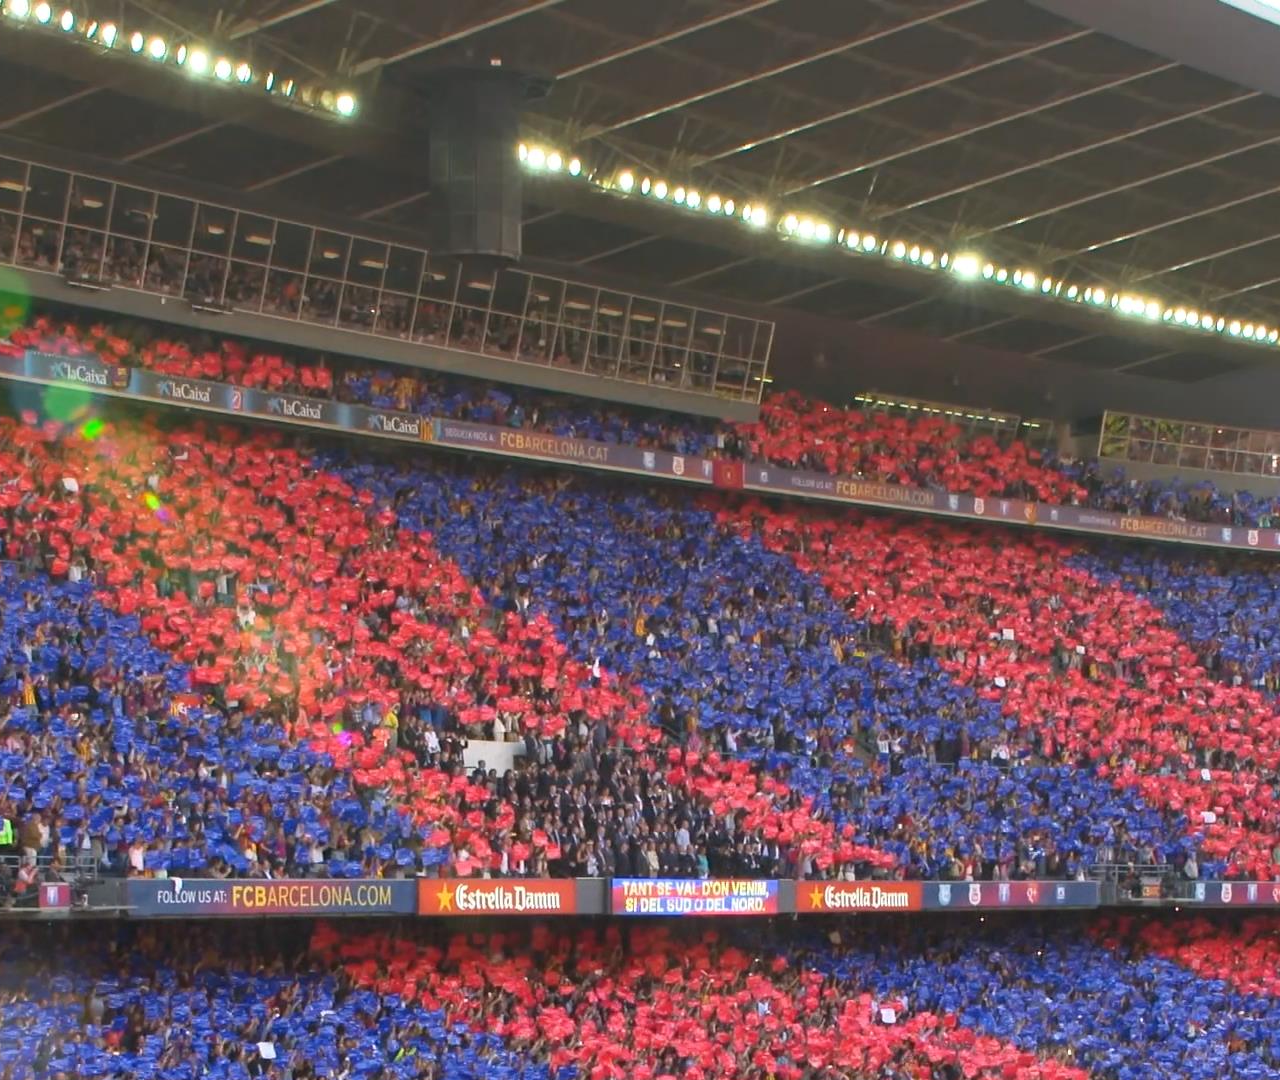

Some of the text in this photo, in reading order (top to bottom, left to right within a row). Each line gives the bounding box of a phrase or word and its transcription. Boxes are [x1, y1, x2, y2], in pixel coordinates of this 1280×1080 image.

[157, 889, 195, 906] FOLLOW
[197, 889, 211, 905] US
[232, 885, 392, 908] FCBARCELONA.COM
[455, 883, 561, 910] Estrella Damm
[623, 882, 655, 895] TANT
[657, 882, 672, 895] SE
[676, 882, 698, 895] VAL
[824, 884, 908, 908] Estrella Damm
[626, 898, 638, 912] SI
[640, 898, 664, 912] DEL
[666, 898, 691, 912] SUD
[706, 898, 729, 912] DEL
